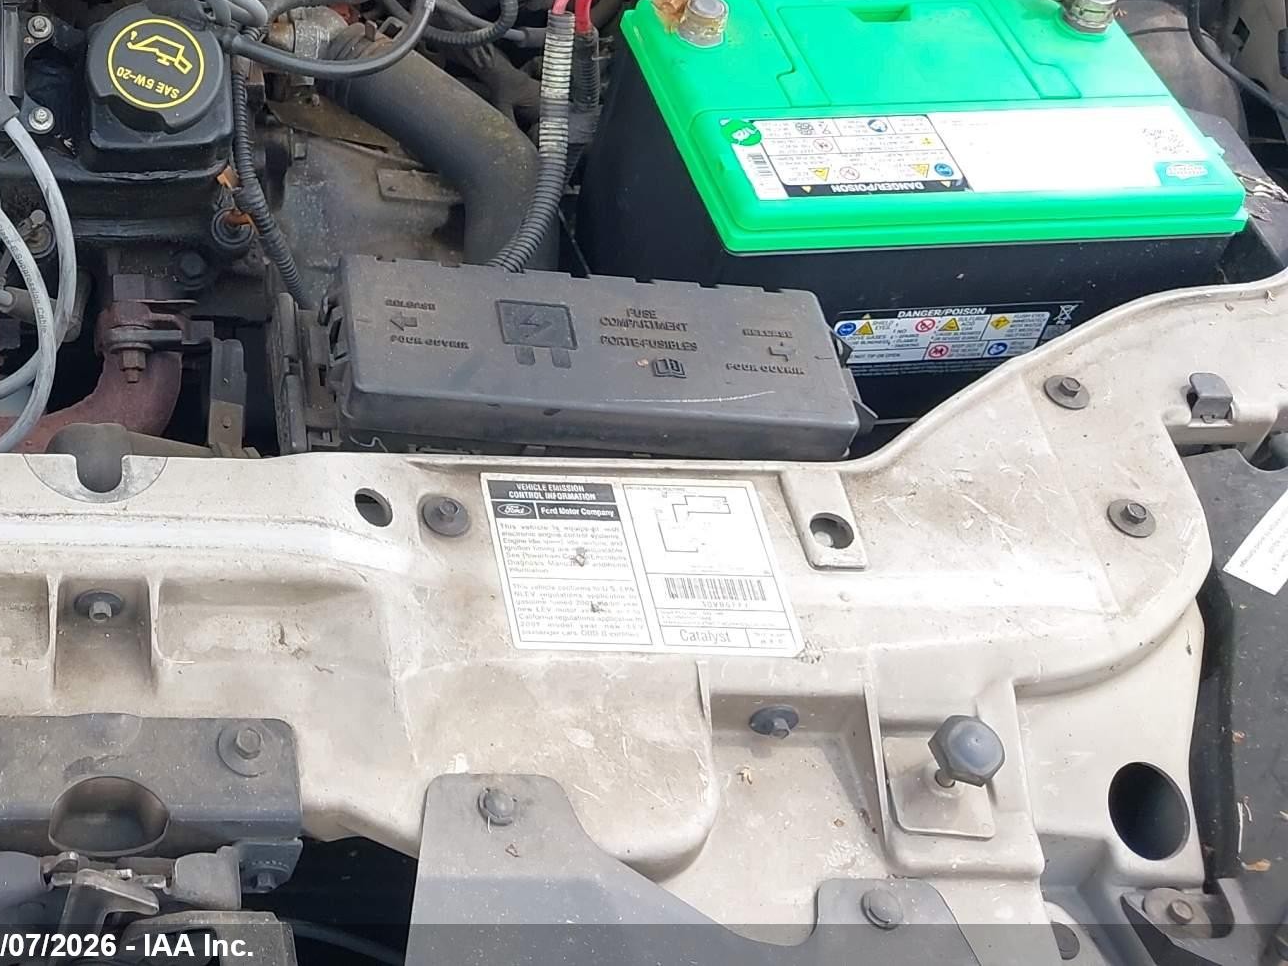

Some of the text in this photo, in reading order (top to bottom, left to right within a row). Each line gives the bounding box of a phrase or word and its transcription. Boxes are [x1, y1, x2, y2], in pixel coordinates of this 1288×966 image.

[116, 66, 180, 99] SAE 5W-20
[830, 181, 924, 193] DANGER/POISON
[15, 253, 41, 305] Suppression
[37, 304, 48, 333] Cable
[385, 299, 436, 311] RELEASE
[626, 308, 658, 319] FUSE
[897, 307, 987, 318] DANGER/POISON
[599, 317, 688, 332] COMPARTMENT
[742, 329, 793, 338] RELEASE
[390, 334, 470, 349] POUR OUVRIR
[600, 335, 698, 351] PORTE-FUSIBLES
[726, 363, 805, 375] POUR OUVRIR
[515, 483, 585, 492] VEHICLE EMISSION
[508, 491, 596, 501] CONTROL INFORMATION
[540, 507, 614, 517] Ford Motor Company
[679, 628, 732, 645] Catalyst
